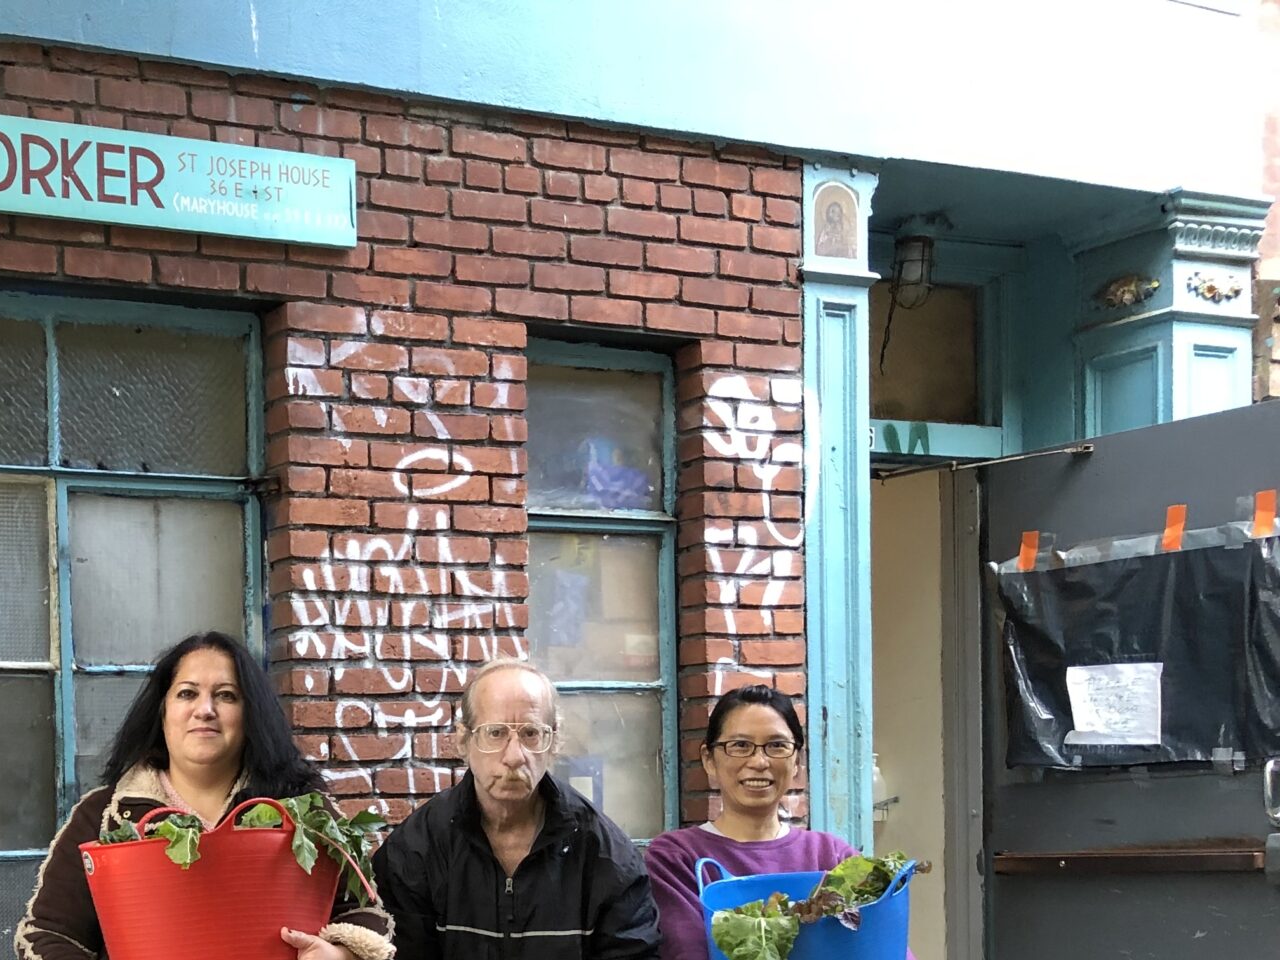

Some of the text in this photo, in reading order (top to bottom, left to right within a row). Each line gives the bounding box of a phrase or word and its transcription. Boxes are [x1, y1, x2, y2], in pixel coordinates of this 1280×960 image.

[178, 152, 331, 188] ST JOSEPH HOUSE
[209, 179, 228, 196] 36
[234, 182, 243, 198] E
[264, 186, 283, 202] ST
